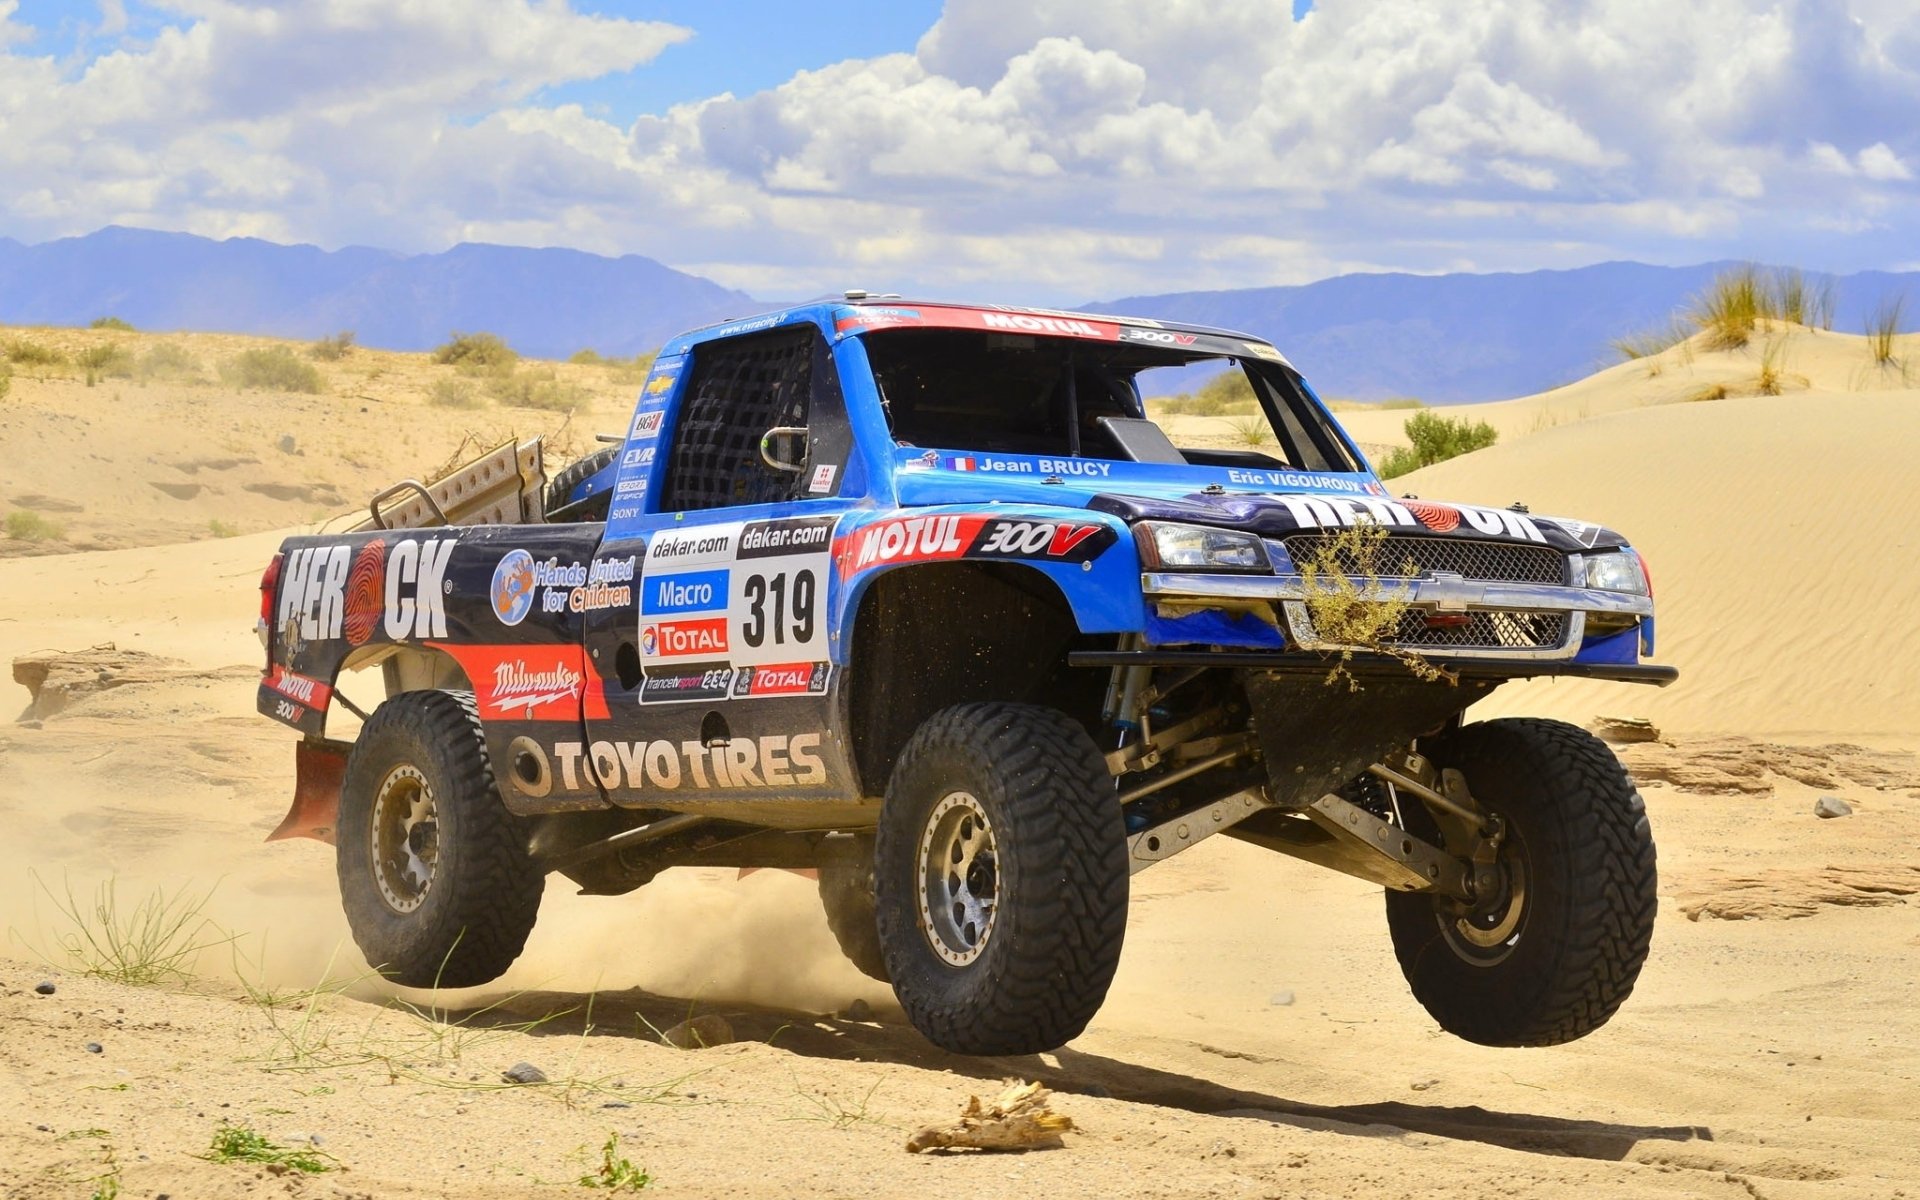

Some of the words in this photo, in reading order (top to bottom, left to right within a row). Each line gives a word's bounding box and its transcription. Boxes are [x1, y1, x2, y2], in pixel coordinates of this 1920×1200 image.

[981, 313, 1102, 336] MOTUL
[1128, 329, 1199, 346] 300V
[622, 447, 656, 464] EVR
[980, 458, 1033, 473] Jean
[1039, 460, 1111, 478] BRUCY
[1228, 470, 1265, 485] Eric
[1267, 473, 1362, 493] VIGOUROUX
[612, 508, 640, 520] SONY
[652, 535, 729, 559] dakar.com
[743, 525, 827, 550] dakar.com
[856, 516, 961, 569] MOTUL
[980, 523, 1102, 556] 300V
[535, 557, 587, 586] Hands
[588, 556, 637, 582] United
[542, 586, 568, 613] for
[569, 584, 632, 613] Children
[658, 580, 713, 607] Macro
[743, 568, 816, 648] 319
[661, 626, 726, 651] TOTAL
[277, 670, 315, 703] MOTUL
[491, 660, 580, 700] Milwaukee
[757, 670, 807, 688] TOTAL
[275, 700, 305, 723] 300V
